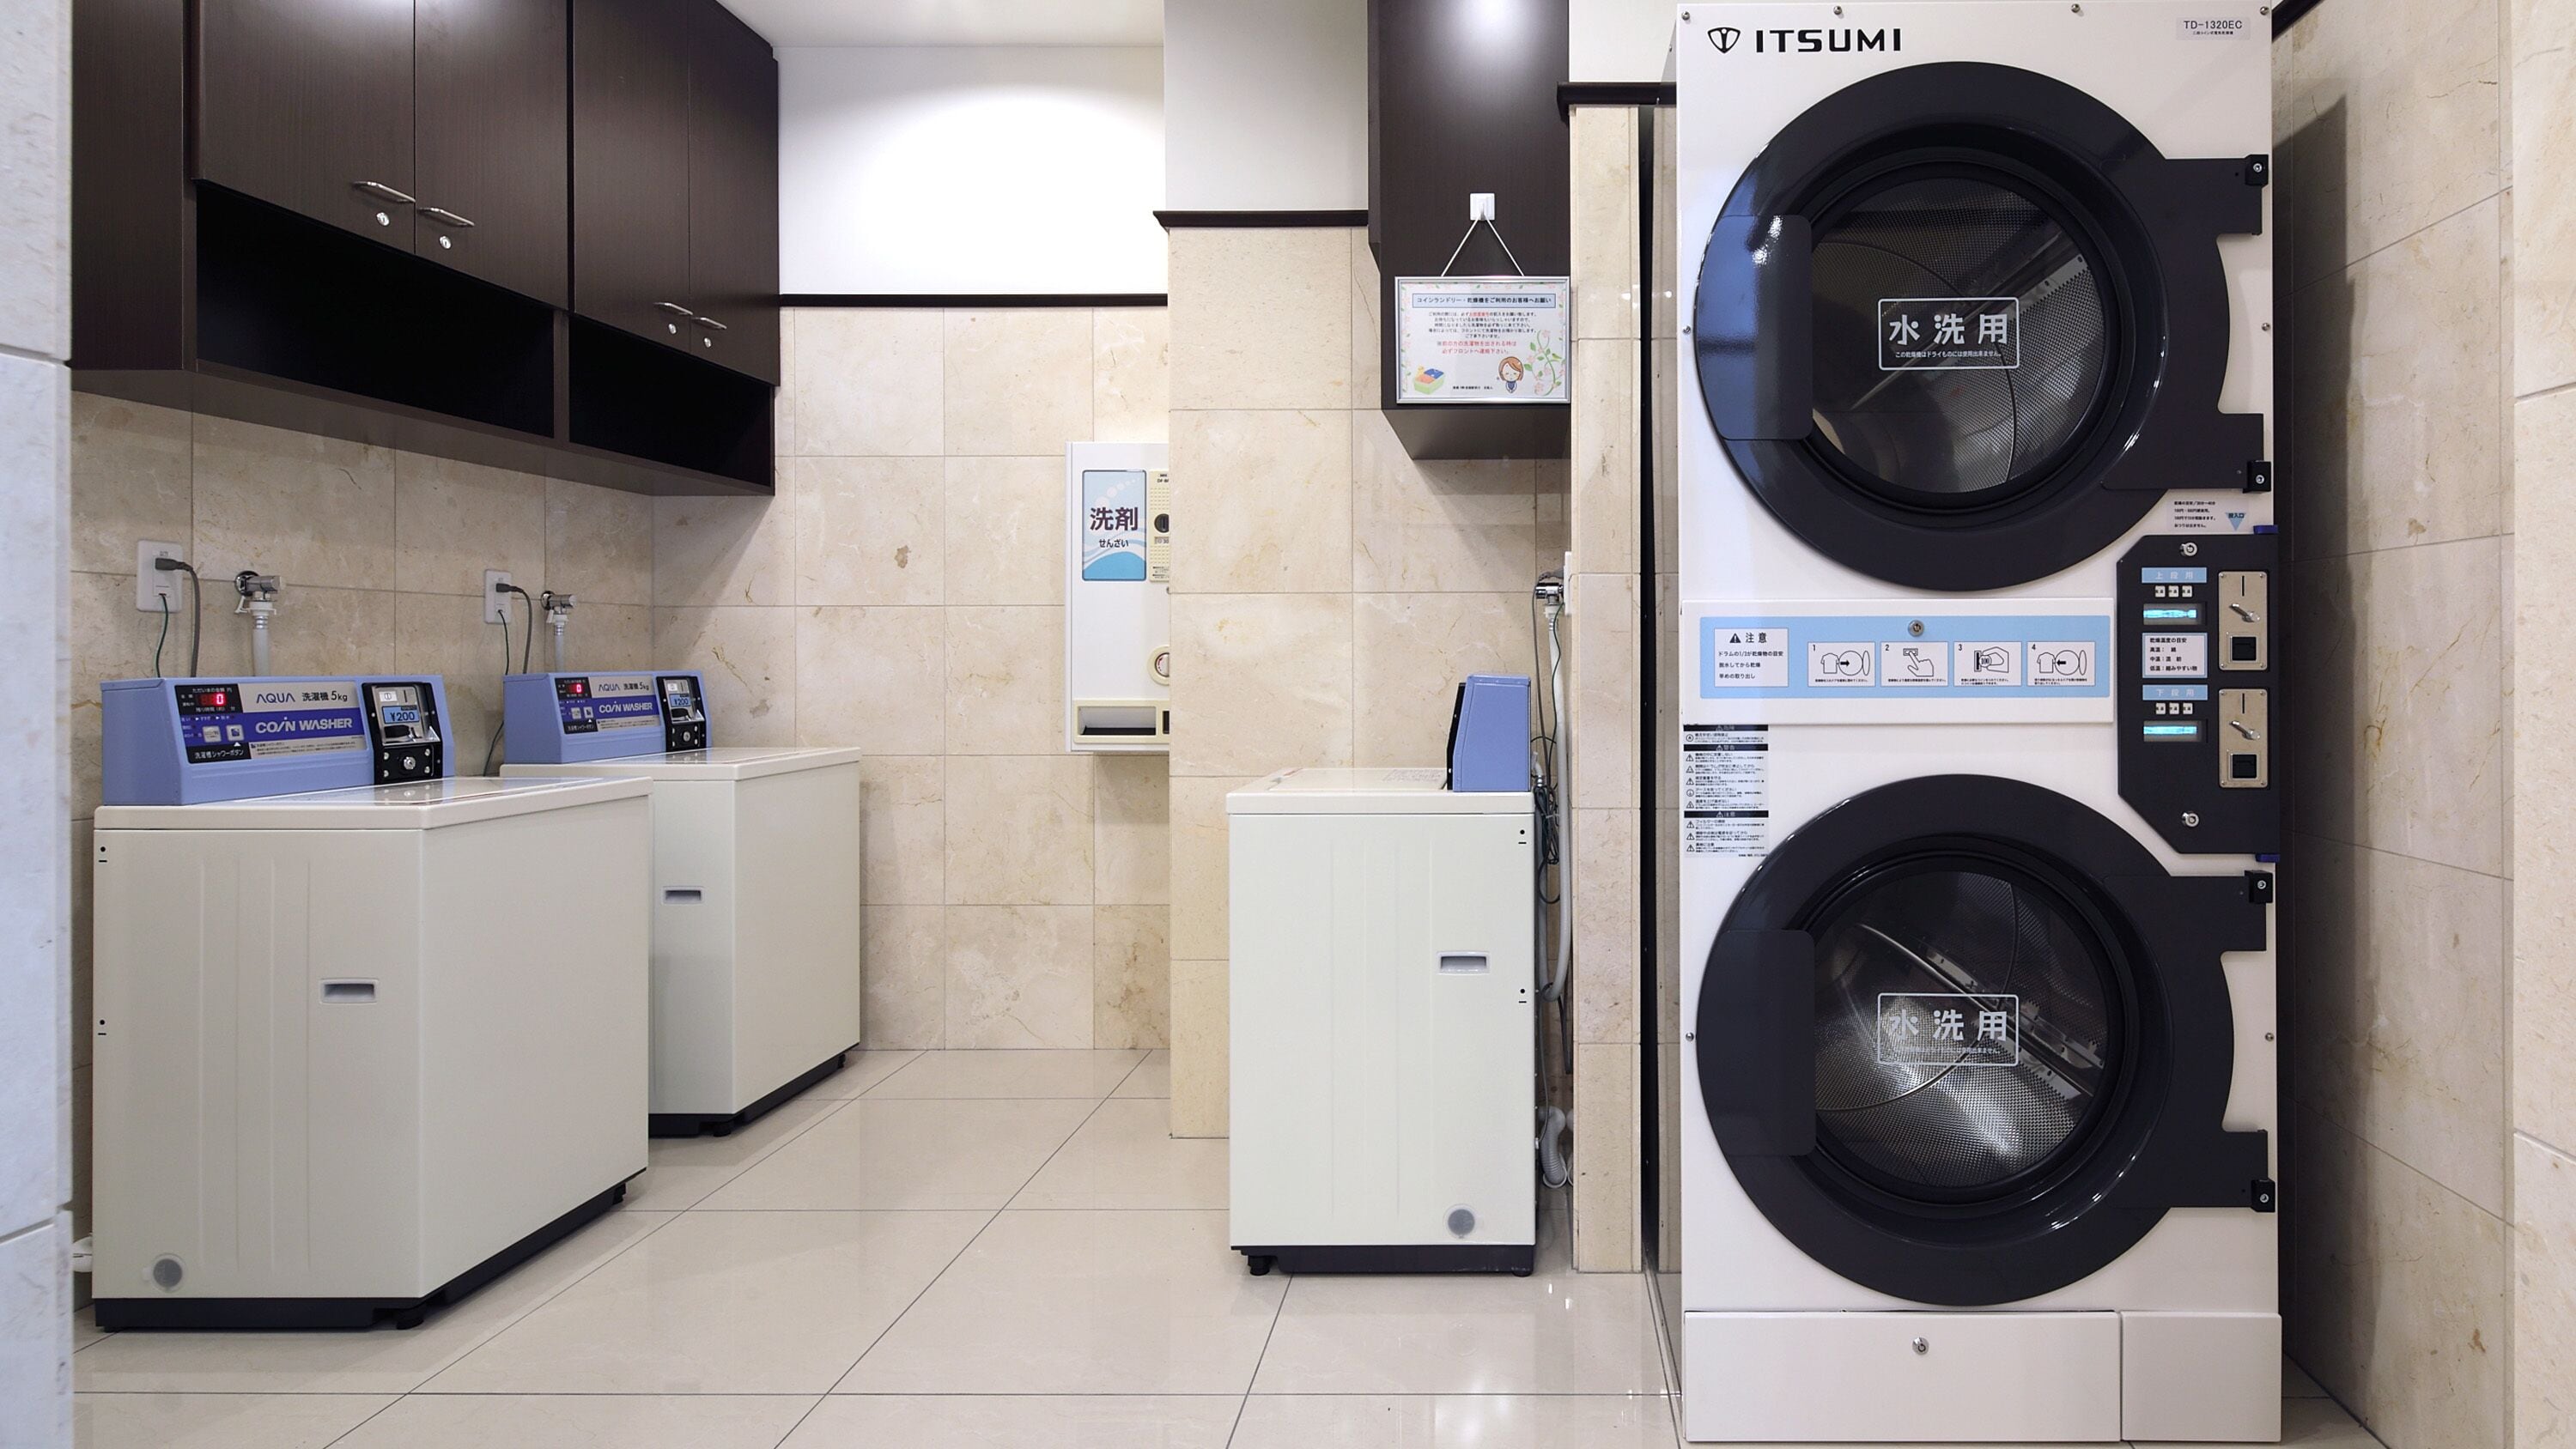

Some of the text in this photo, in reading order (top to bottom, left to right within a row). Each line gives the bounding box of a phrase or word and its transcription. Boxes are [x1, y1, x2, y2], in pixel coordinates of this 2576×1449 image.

[1756, 28, 1900, 52] ITSUMI
[1889, 313, 2008, 345] 水洗用
[1090, 506, 1139, 531] 洗剤
[1098, 538, 1129, 549] せんざい
[1745, 632, 1767, 644] 注意
[576, 684, 582, 693] 0
[216, 694, 224, 705] 0
[302, 692, 328, 701] 洗濯機
[331, 690, 348, 702] 5kg
[623, 702, 653, 712] WASHER
[298, 718, 353, 731] WASHER
[1889, 1009, 2007, 1041] 水洗用
